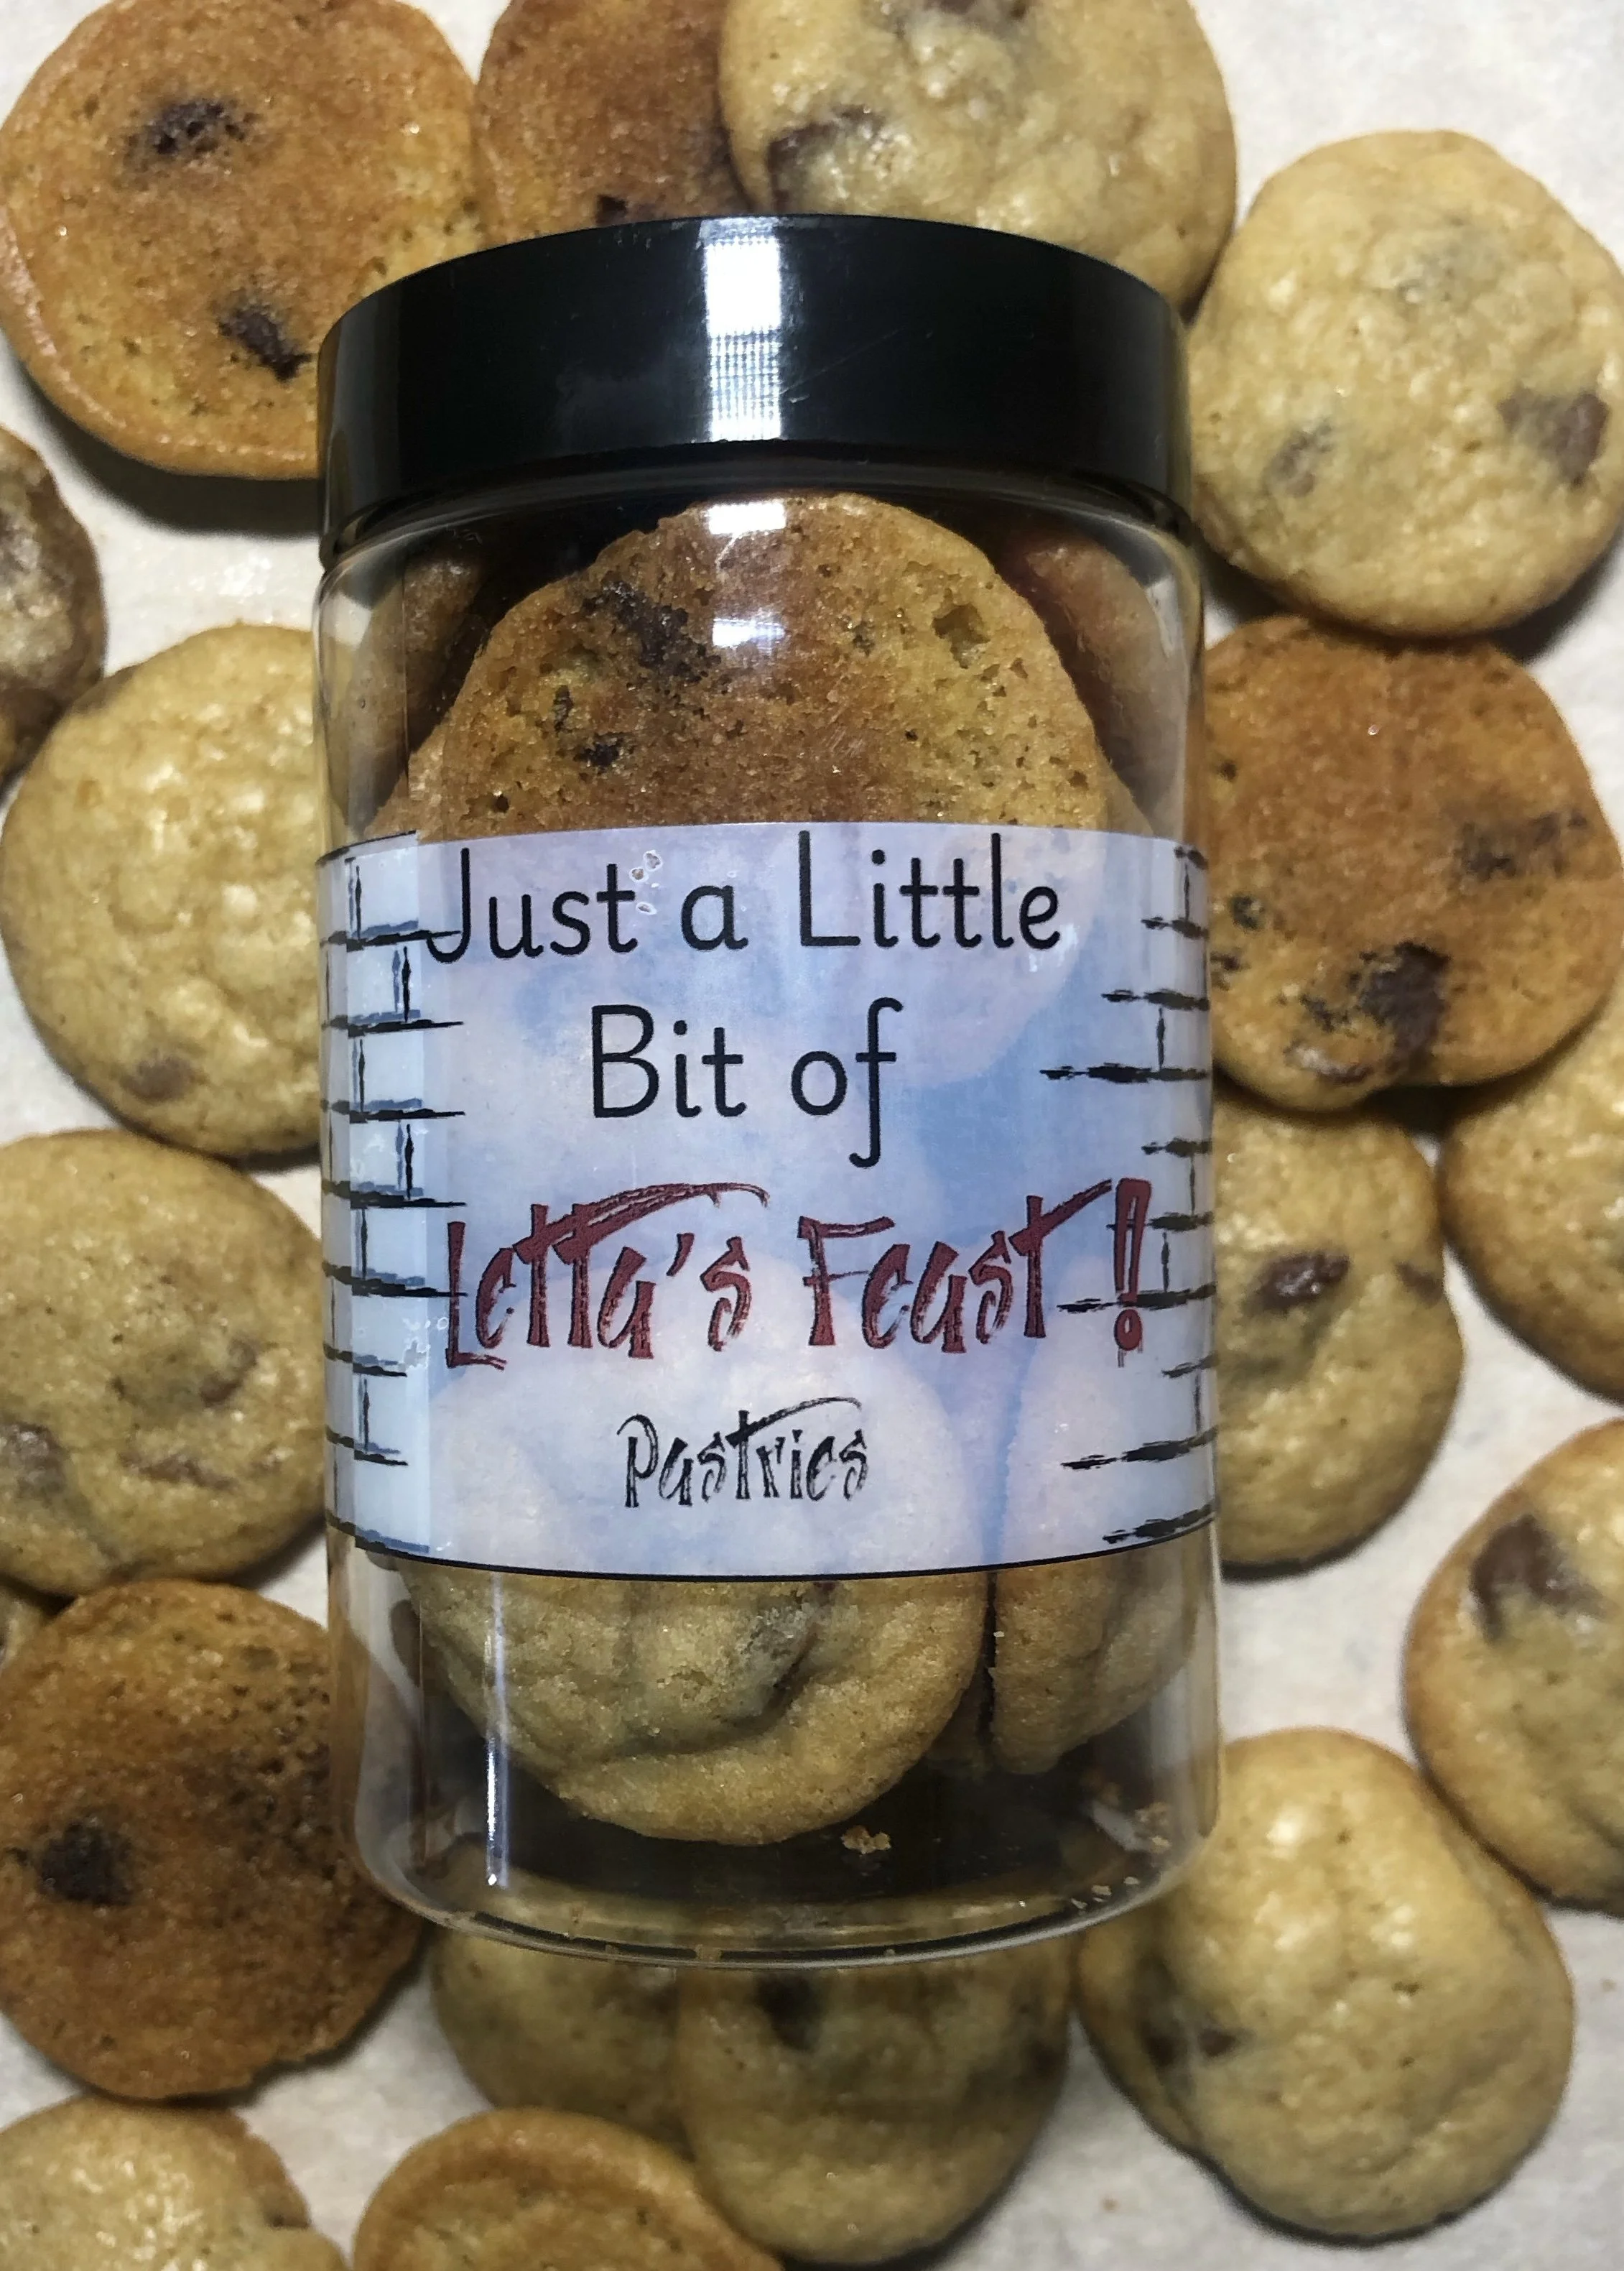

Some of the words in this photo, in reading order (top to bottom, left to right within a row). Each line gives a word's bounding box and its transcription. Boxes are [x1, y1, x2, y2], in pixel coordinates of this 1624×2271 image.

[425, 847, 639, 963] Just
[680, 884, 749, 951] a
[798, 830, 1062, 950] Little
[591, 1004, 748, 1119] Bit
[790, 996, 904, 1169] of
[445, 1181, 771, 1371] Letta's
[616, 1396, 871, 1508] Pastries
